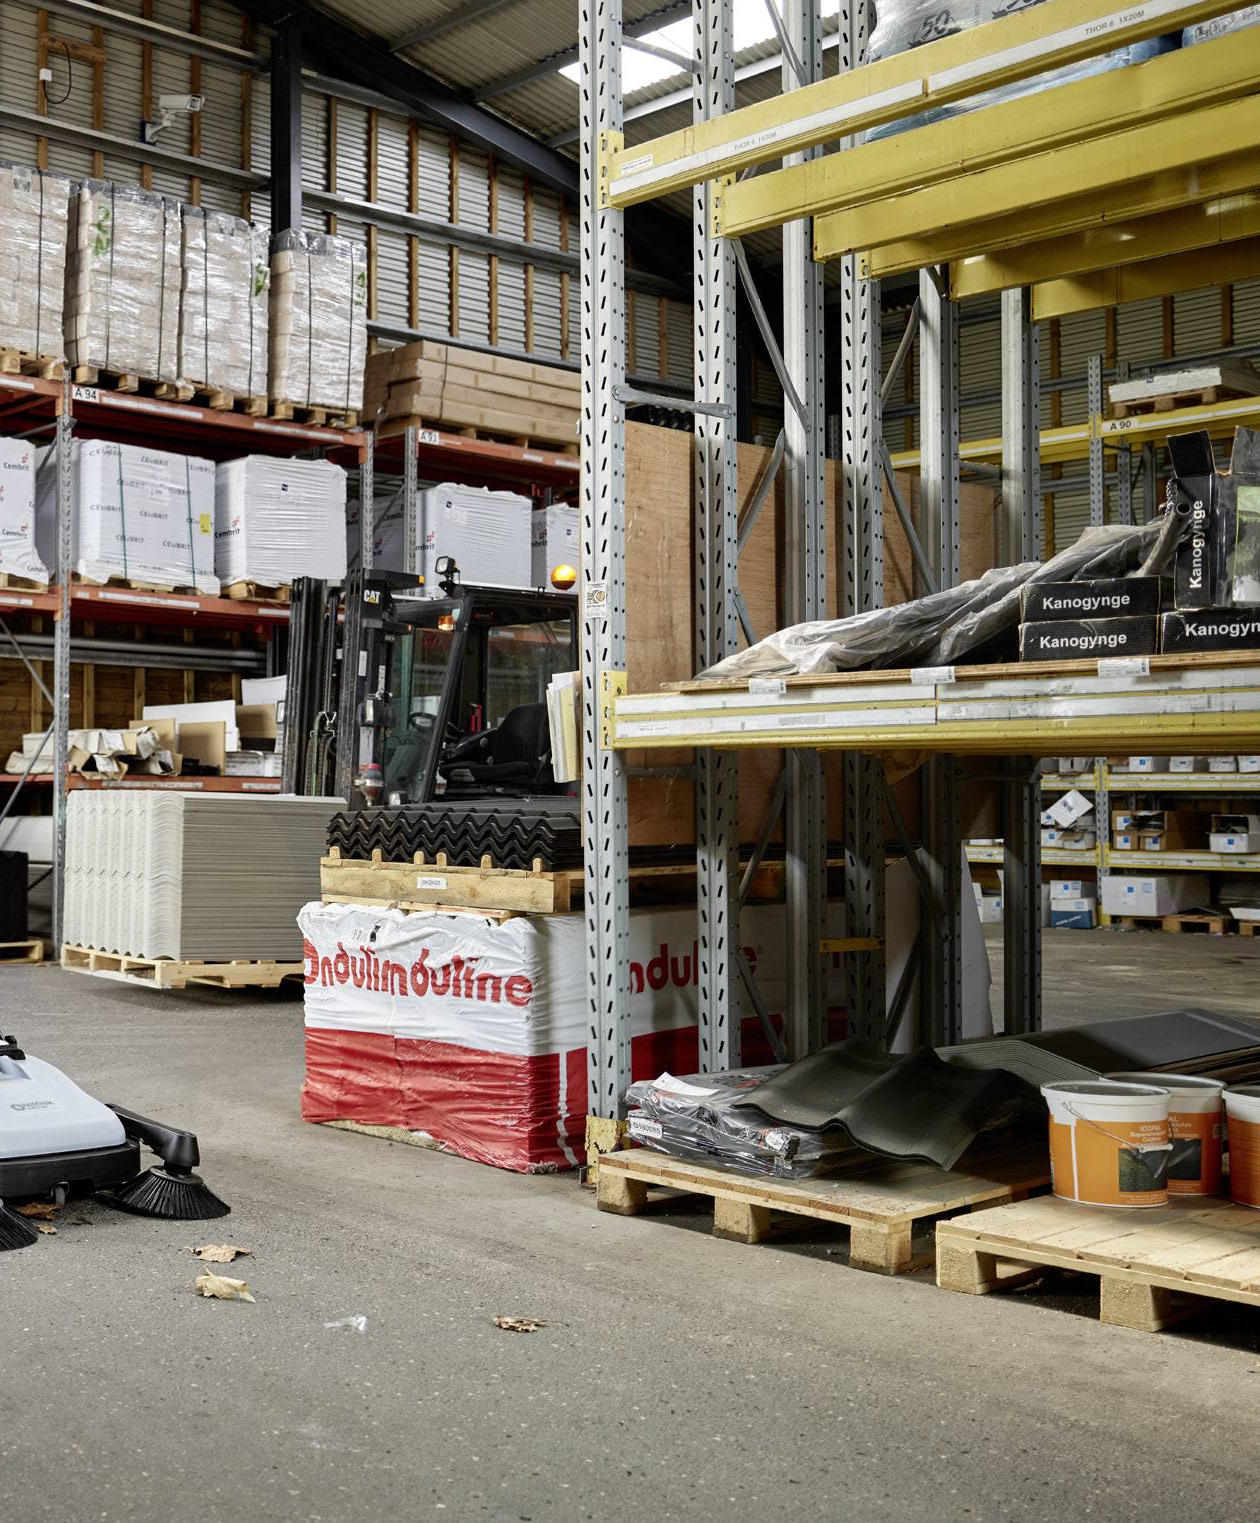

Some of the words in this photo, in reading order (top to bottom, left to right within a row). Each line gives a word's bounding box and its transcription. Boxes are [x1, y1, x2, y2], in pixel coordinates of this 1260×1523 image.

[1085, 23, 1107, 35] THOR
[1119, 10, 1145, 24] 1X20M
[75, 387, 83, 399] A
[85, 388, 97, 400] 94
[1110, 422, 1118, 431] A
[1119, 420, 1132, 430] 90
[421, 431, 428, 440] A
[428, 433, 438, 444] 93
[3, 462, 30, 472] Cembrit
[2, 528, 28, 539] Cembrit
[215, 528, 240, 538] Cembrit
[1189, 500, 1206, 589] Kanogynge
[363, 589, 381, 604] CAT
[1043, 595, 1131, 610] Kanogynge
[1040, 634, 1128, 649] Kanogynge
